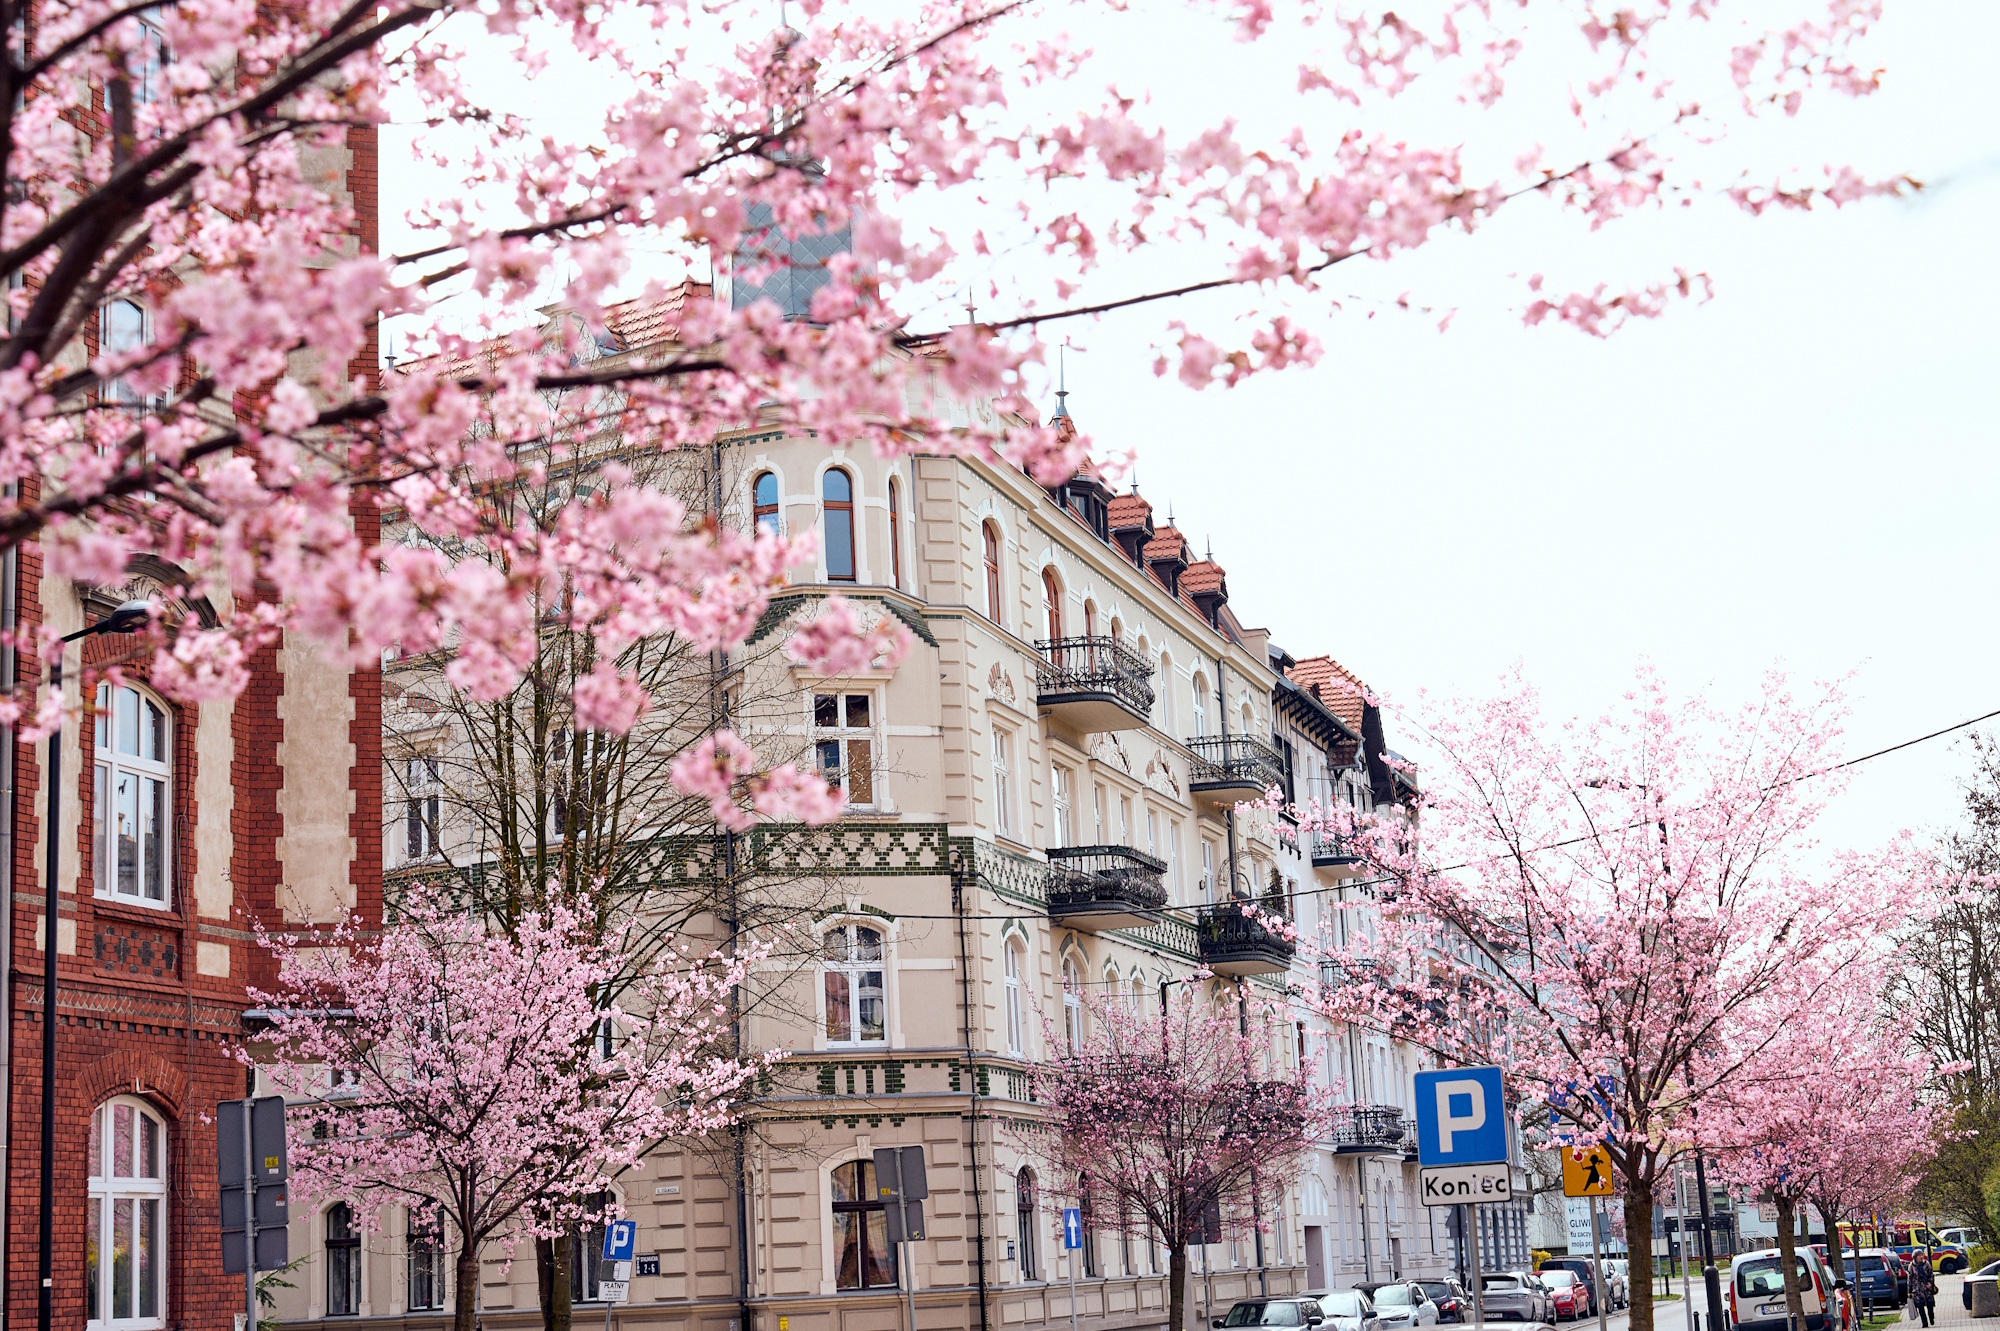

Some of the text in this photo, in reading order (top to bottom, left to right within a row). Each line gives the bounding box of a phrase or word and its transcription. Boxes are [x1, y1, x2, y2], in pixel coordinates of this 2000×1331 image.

[1435, 1079, 1486, 1153] P
[1570, 1219, 1590, 1227] GLIWI
[610, 1224, 629, 1255] P
